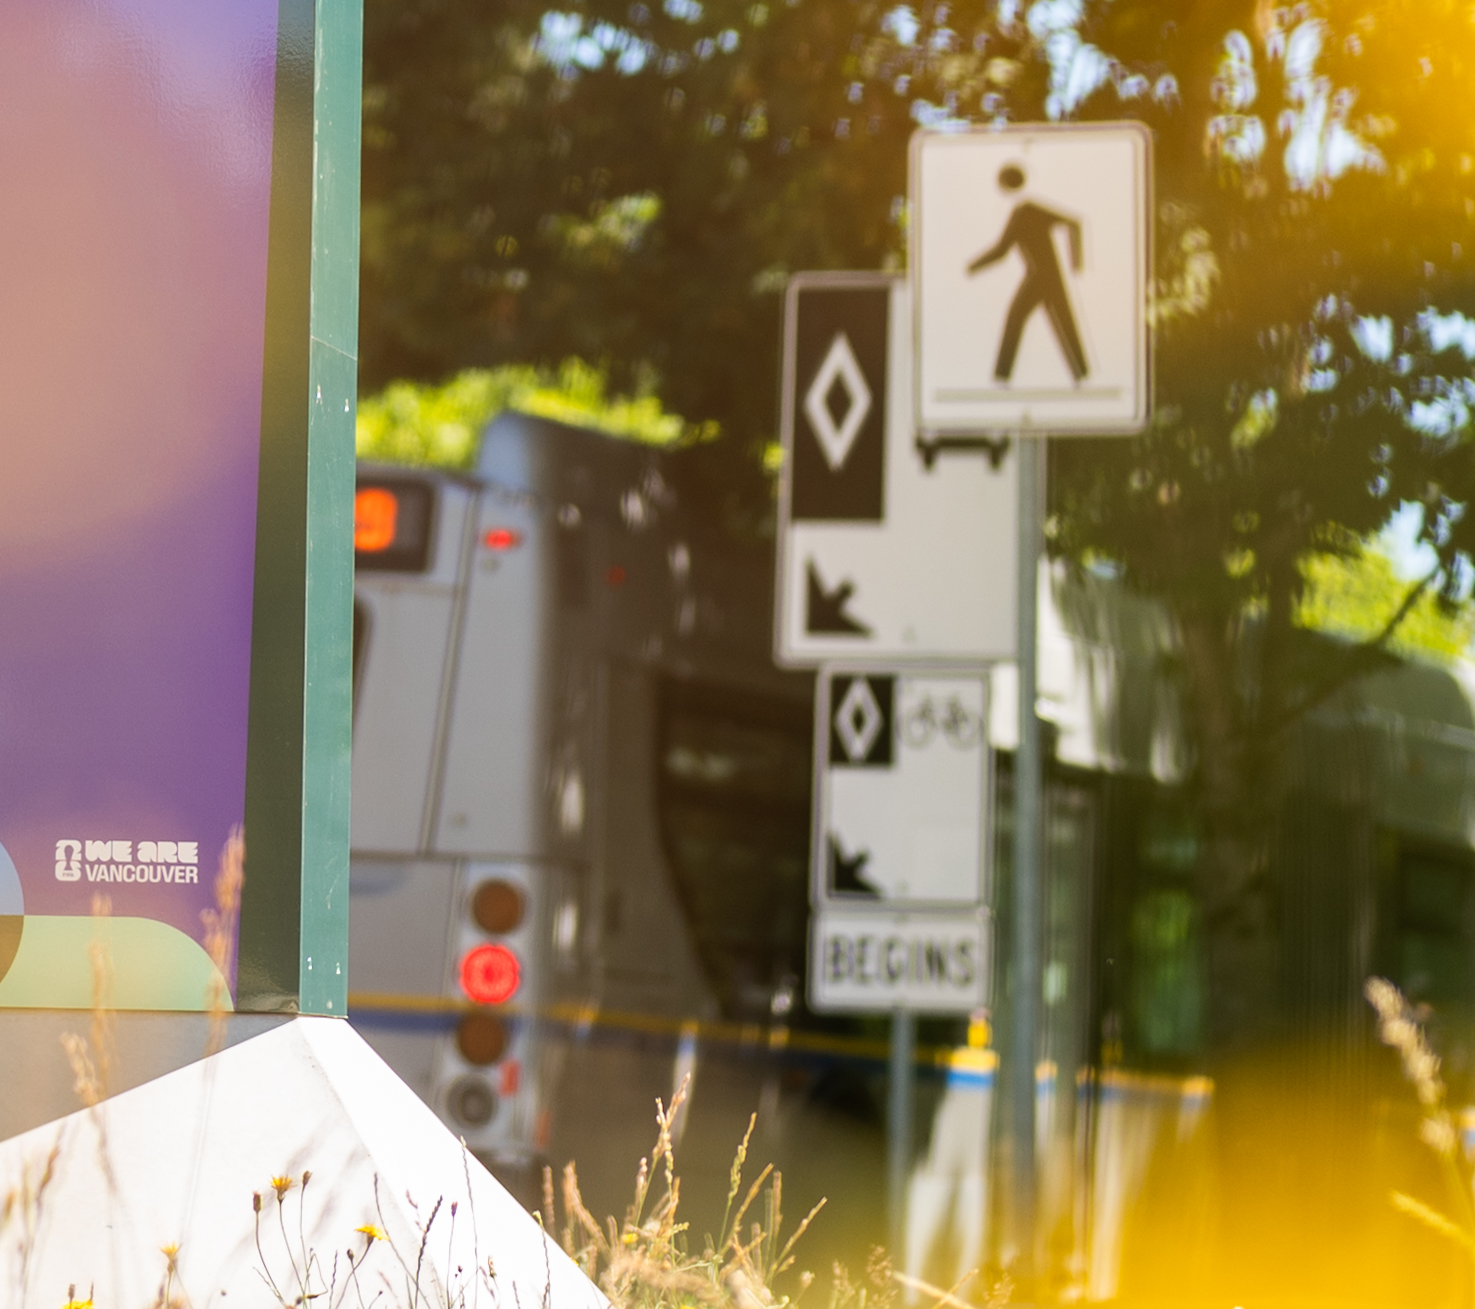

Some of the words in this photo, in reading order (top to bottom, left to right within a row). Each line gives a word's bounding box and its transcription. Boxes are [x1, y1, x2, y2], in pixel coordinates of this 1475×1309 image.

[84, 840, 132, 863] WE
[84, 864, 199, 884] VANCOUVER
[826, 934, 978, 988] BEGINS
